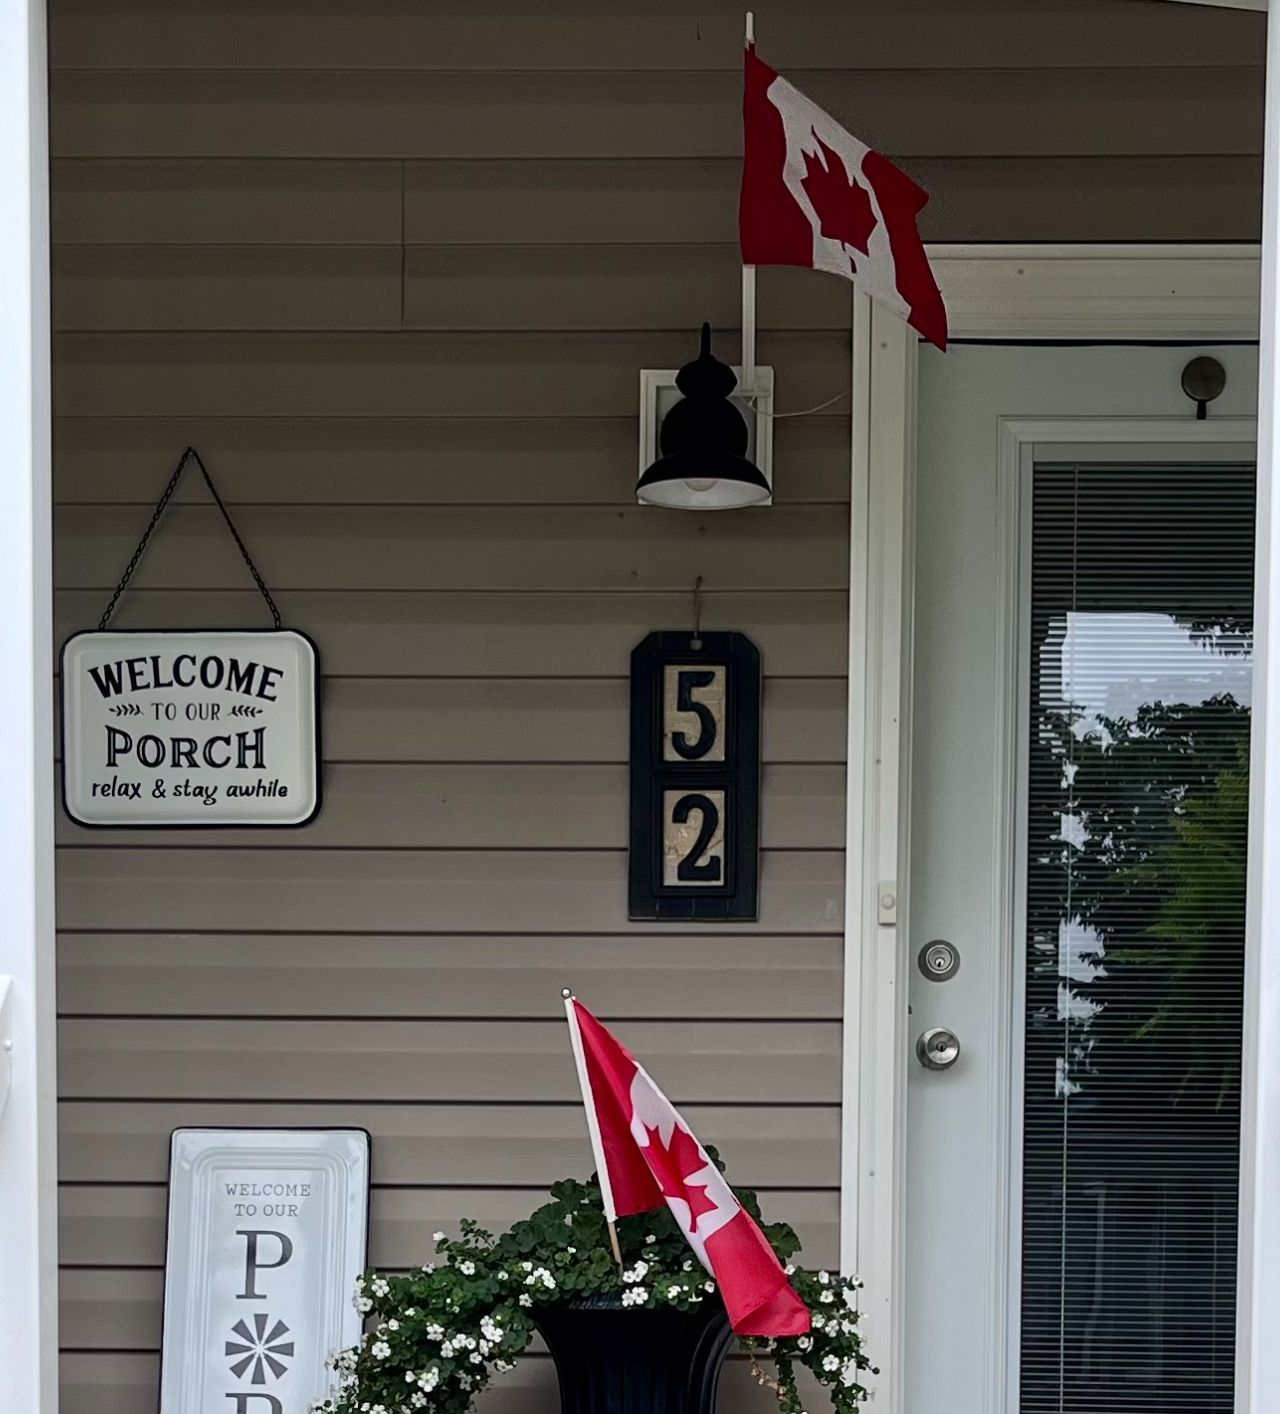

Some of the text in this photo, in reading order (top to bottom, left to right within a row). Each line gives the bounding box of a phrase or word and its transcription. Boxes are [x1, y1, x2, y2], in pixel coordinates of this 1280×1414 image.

[87, 654, 284, 702] WELCOME
[151, 702, 221, 721] TO OUR
[104, 724, 267, 769] PORCH
[92, 775, 289, 806] relax & stay awhile
[224, 1183, 312, 1197] WELCOME
[234, 1204, 299, 1217] TO OUR
